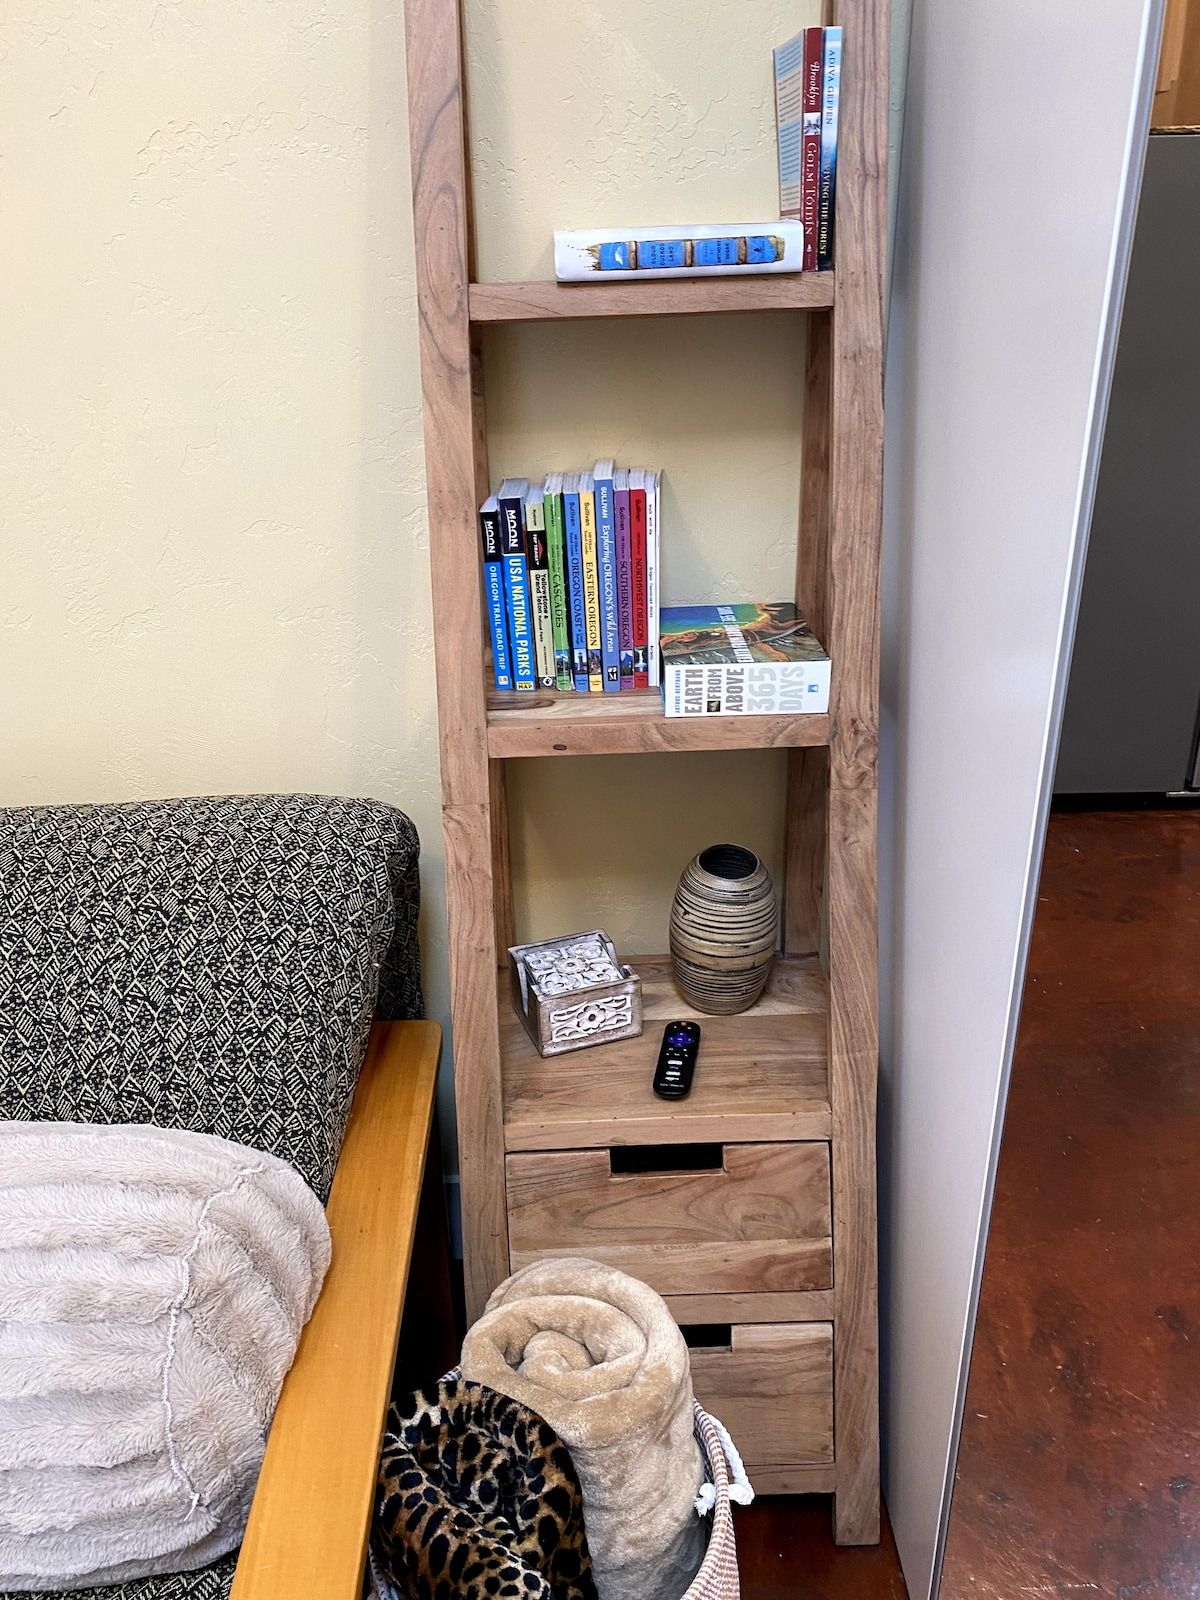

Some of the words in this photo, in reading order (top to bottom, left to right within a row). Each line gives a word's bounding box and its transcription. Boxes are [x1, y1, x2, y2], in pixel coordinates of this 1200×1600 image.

[808, 61, 821, 106] Brooklyn
[826, 49, 837, 82] ADIVA
[825, 86, 836, 126] GEFFEN
[805, 142, 818, 182] COLM
[820, 201, 829, 220] THE
[819, 222, 829, 256] FOREST
[569, 501, 577, 527] Sullivan
[600, 486, 609, 519] SULLIVAN
[485, 520, 497, 555] MOON
[505, 509, 519, 548] MOON
[600, 525, 614, 563] Exploring
[489, 565, 500, 601] OREGON
[509, 558, 523, 583] USA
[534, 573, 542, 594] Grand
[571, 557, 581, 597] OREGON
[586, 561, 596, 604] EASTERN
[603, 563, 616, 611] OREGON'S
[620, 560, 630, 609] SOUTHERN
[635, 557, 643, 607] NORTHWEST
[511, 585, 528, 638] NATIONAL
[541, 573, 549, 614] Yellowstone
[552, 574, 564, 628] CASCADES
[493, 602, 503, 627] TRAIL
[573, 598, 583, 628] COAST
[588, 606, 598, 647] OREGON
[606, 611, 617, 630] Wild
[621, 610, 631, 648] OREGON
[636, 607, 644, 641] OREGON
[496, 628, 505, 651] ROAD
[516, 640, 531, 676] PARKS
[607, 631, 616, 653] Areas
[497, 652, 506, 671] TRIP
[684, 669, 703, 714] EARTH
[707, 668, 722, 700] FROM
[725, 668, 744, 713] ABOVE
[747, 667, 777, 712] 365
[779, 665, 804, 711] DAYS
